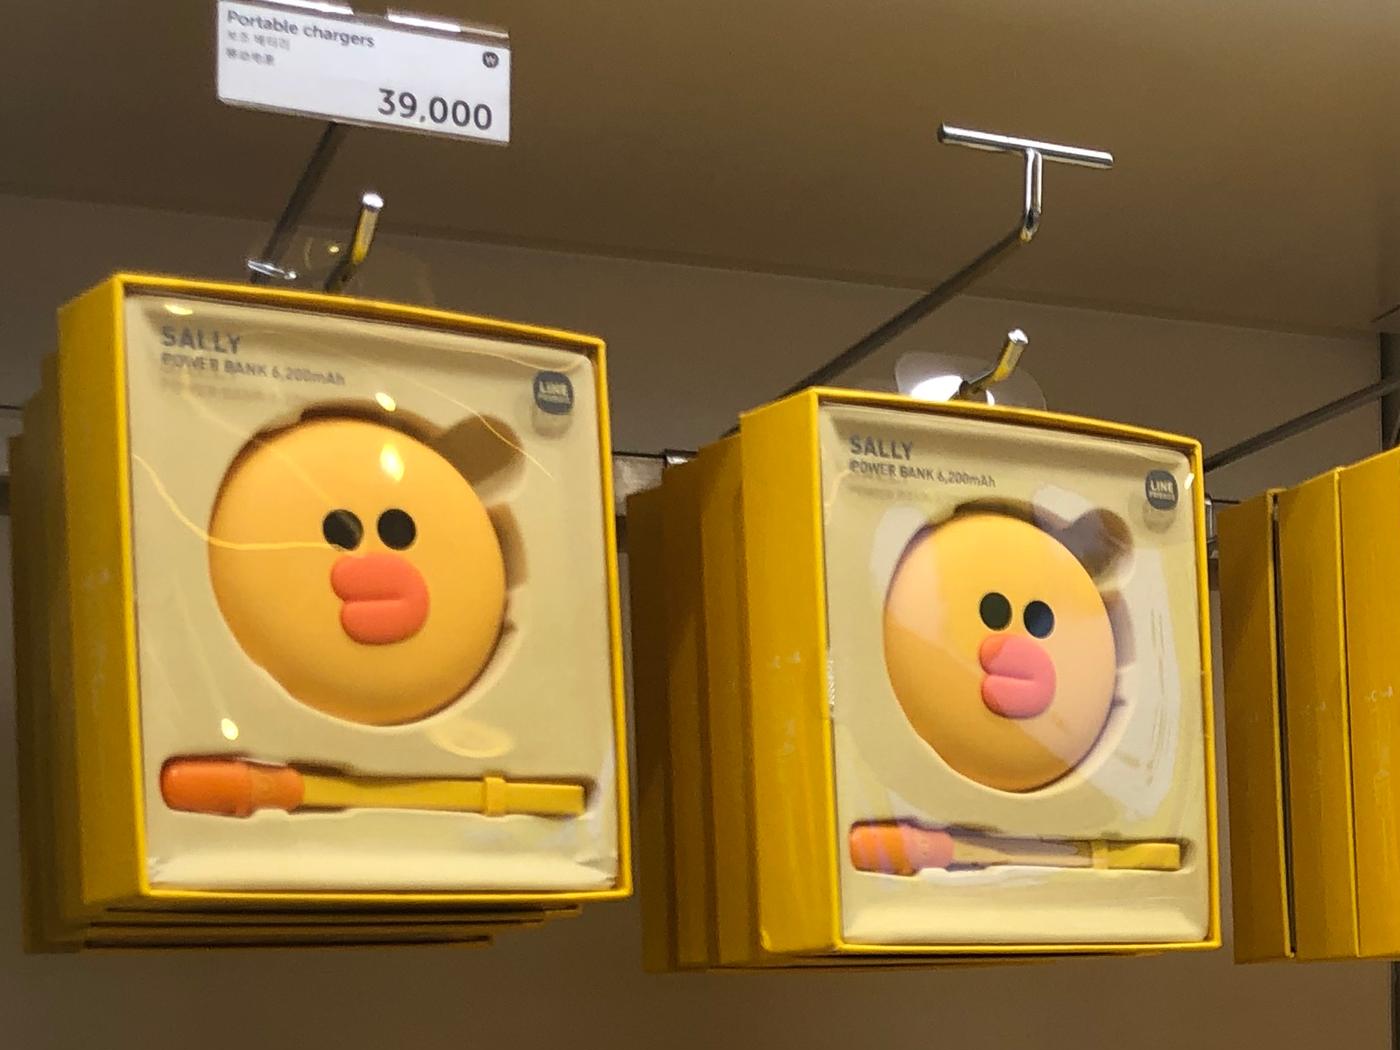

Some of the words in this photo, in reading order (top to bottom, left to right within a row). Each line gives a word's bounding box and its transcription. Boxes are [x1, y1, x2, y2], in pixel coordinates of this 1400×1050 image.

[227, 10, 299, 35] Portable
[303, 24, 375, 48] chargers
[378, 87, 492, 131] 39,000
[162, 326, 241, 354] SALLY
[162, 352, 220, 372] POWER
[225, 360, 267, 377] BANK
[271, 364, 346, 386] 6,200mAh
[849, 436, 914, 461] SALLY
[850, 460, 897, 478] POWER
[900, 465, 934, 482] BANK
[937, 468, 997, 489] 6,200mAh
[1150, 478, 1175, 495] LINE
